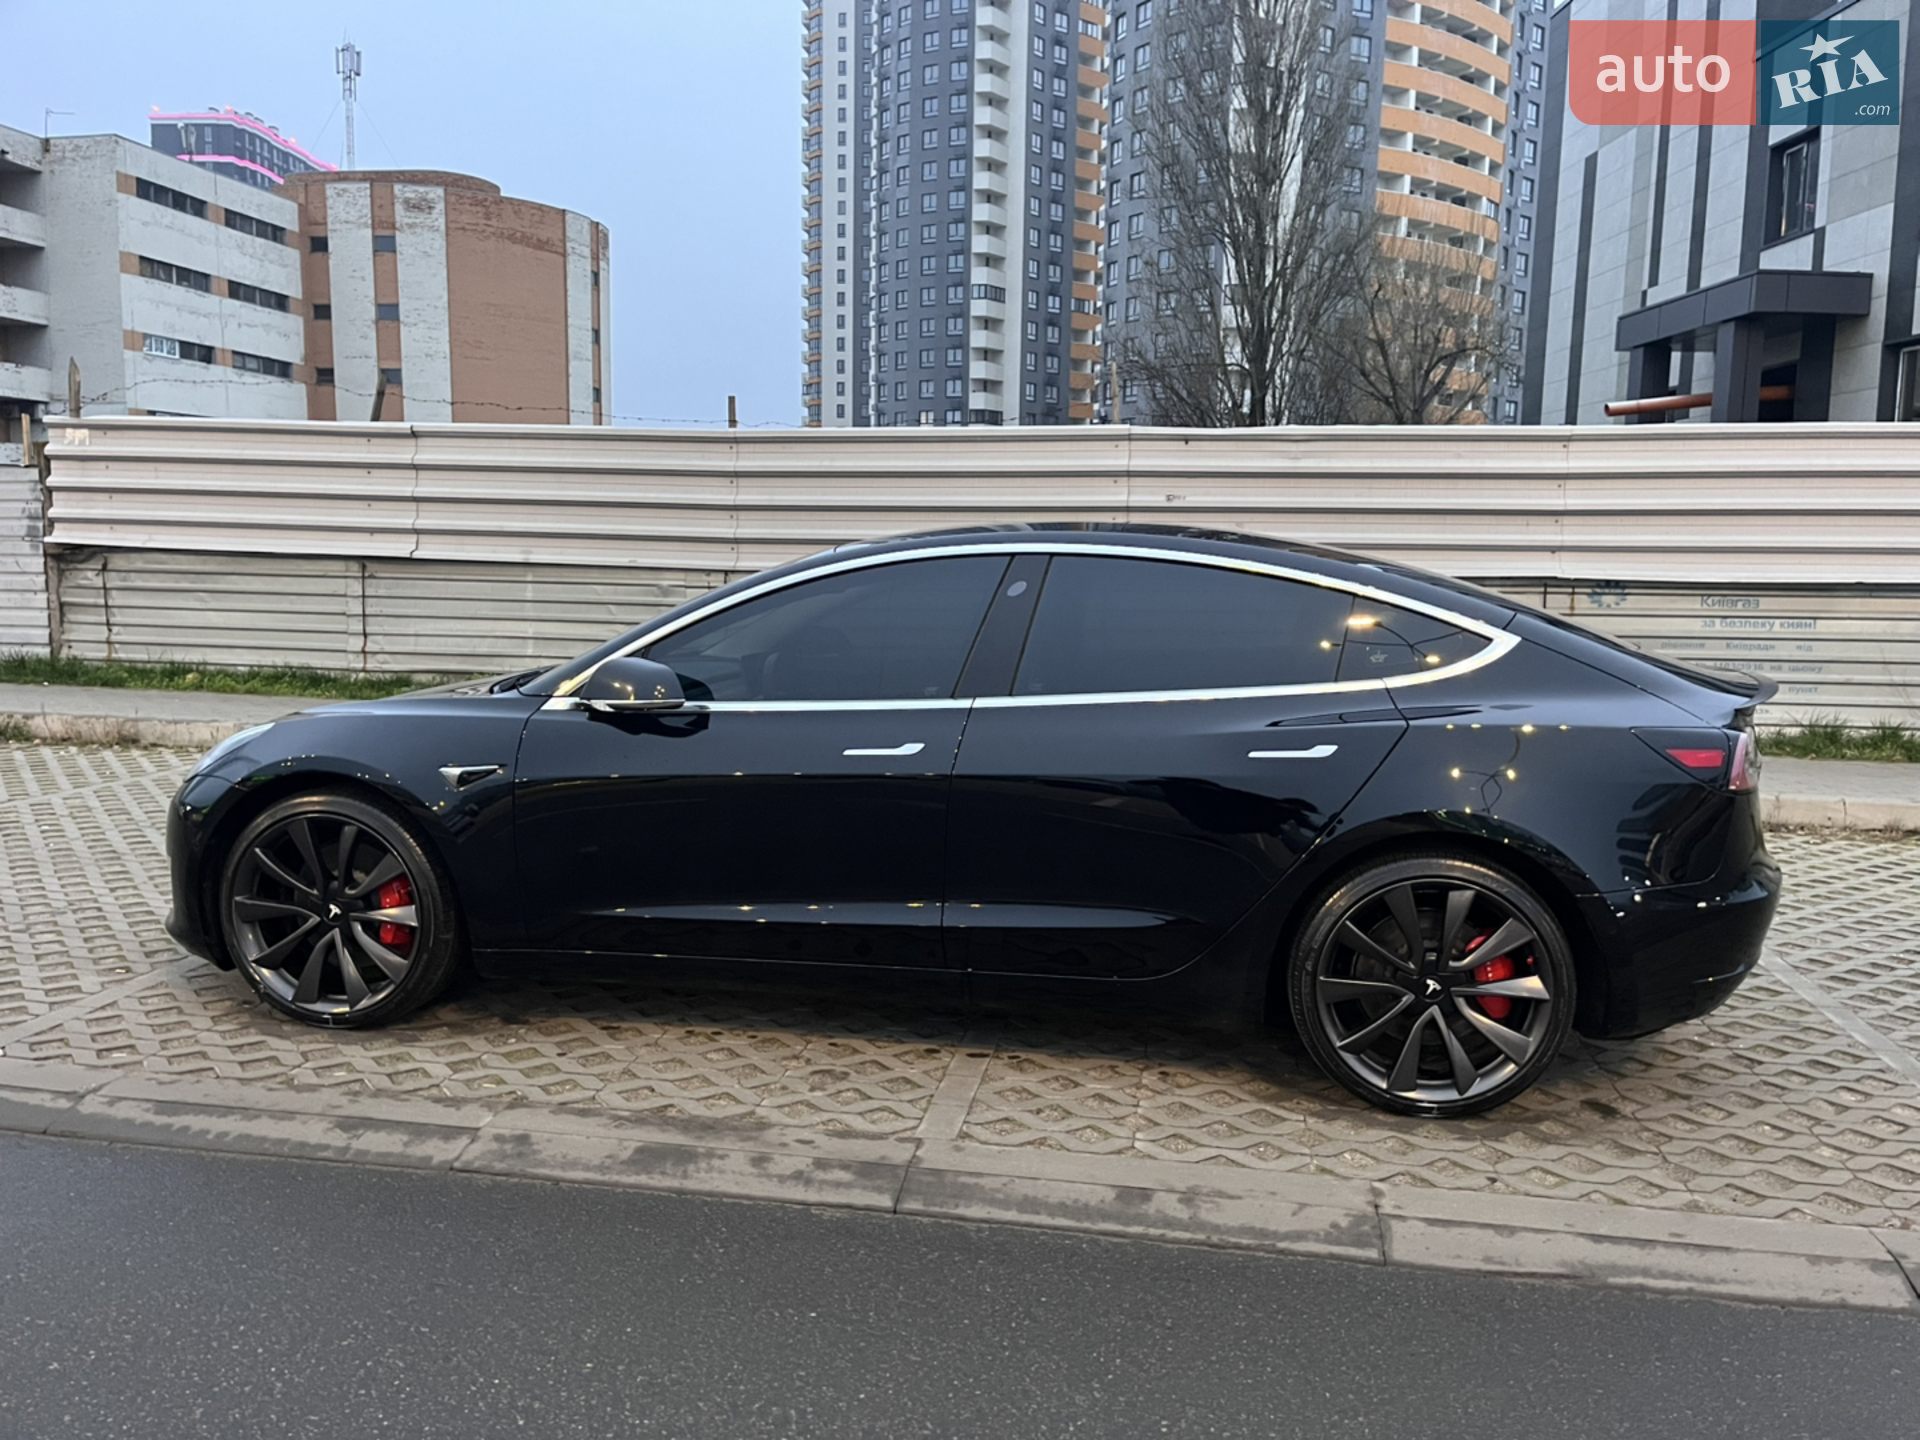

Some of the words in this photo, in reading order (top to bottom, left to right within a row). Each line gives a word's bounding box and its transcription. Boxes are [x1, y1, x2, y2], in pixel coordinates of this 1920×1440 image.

[1700, 595, 1760, 609] Київгаз
[1700, 619, 1716, 628] за
[1720, 617, 1775, 631] безпеку
[1779, 619, 1817, 630] киян!
